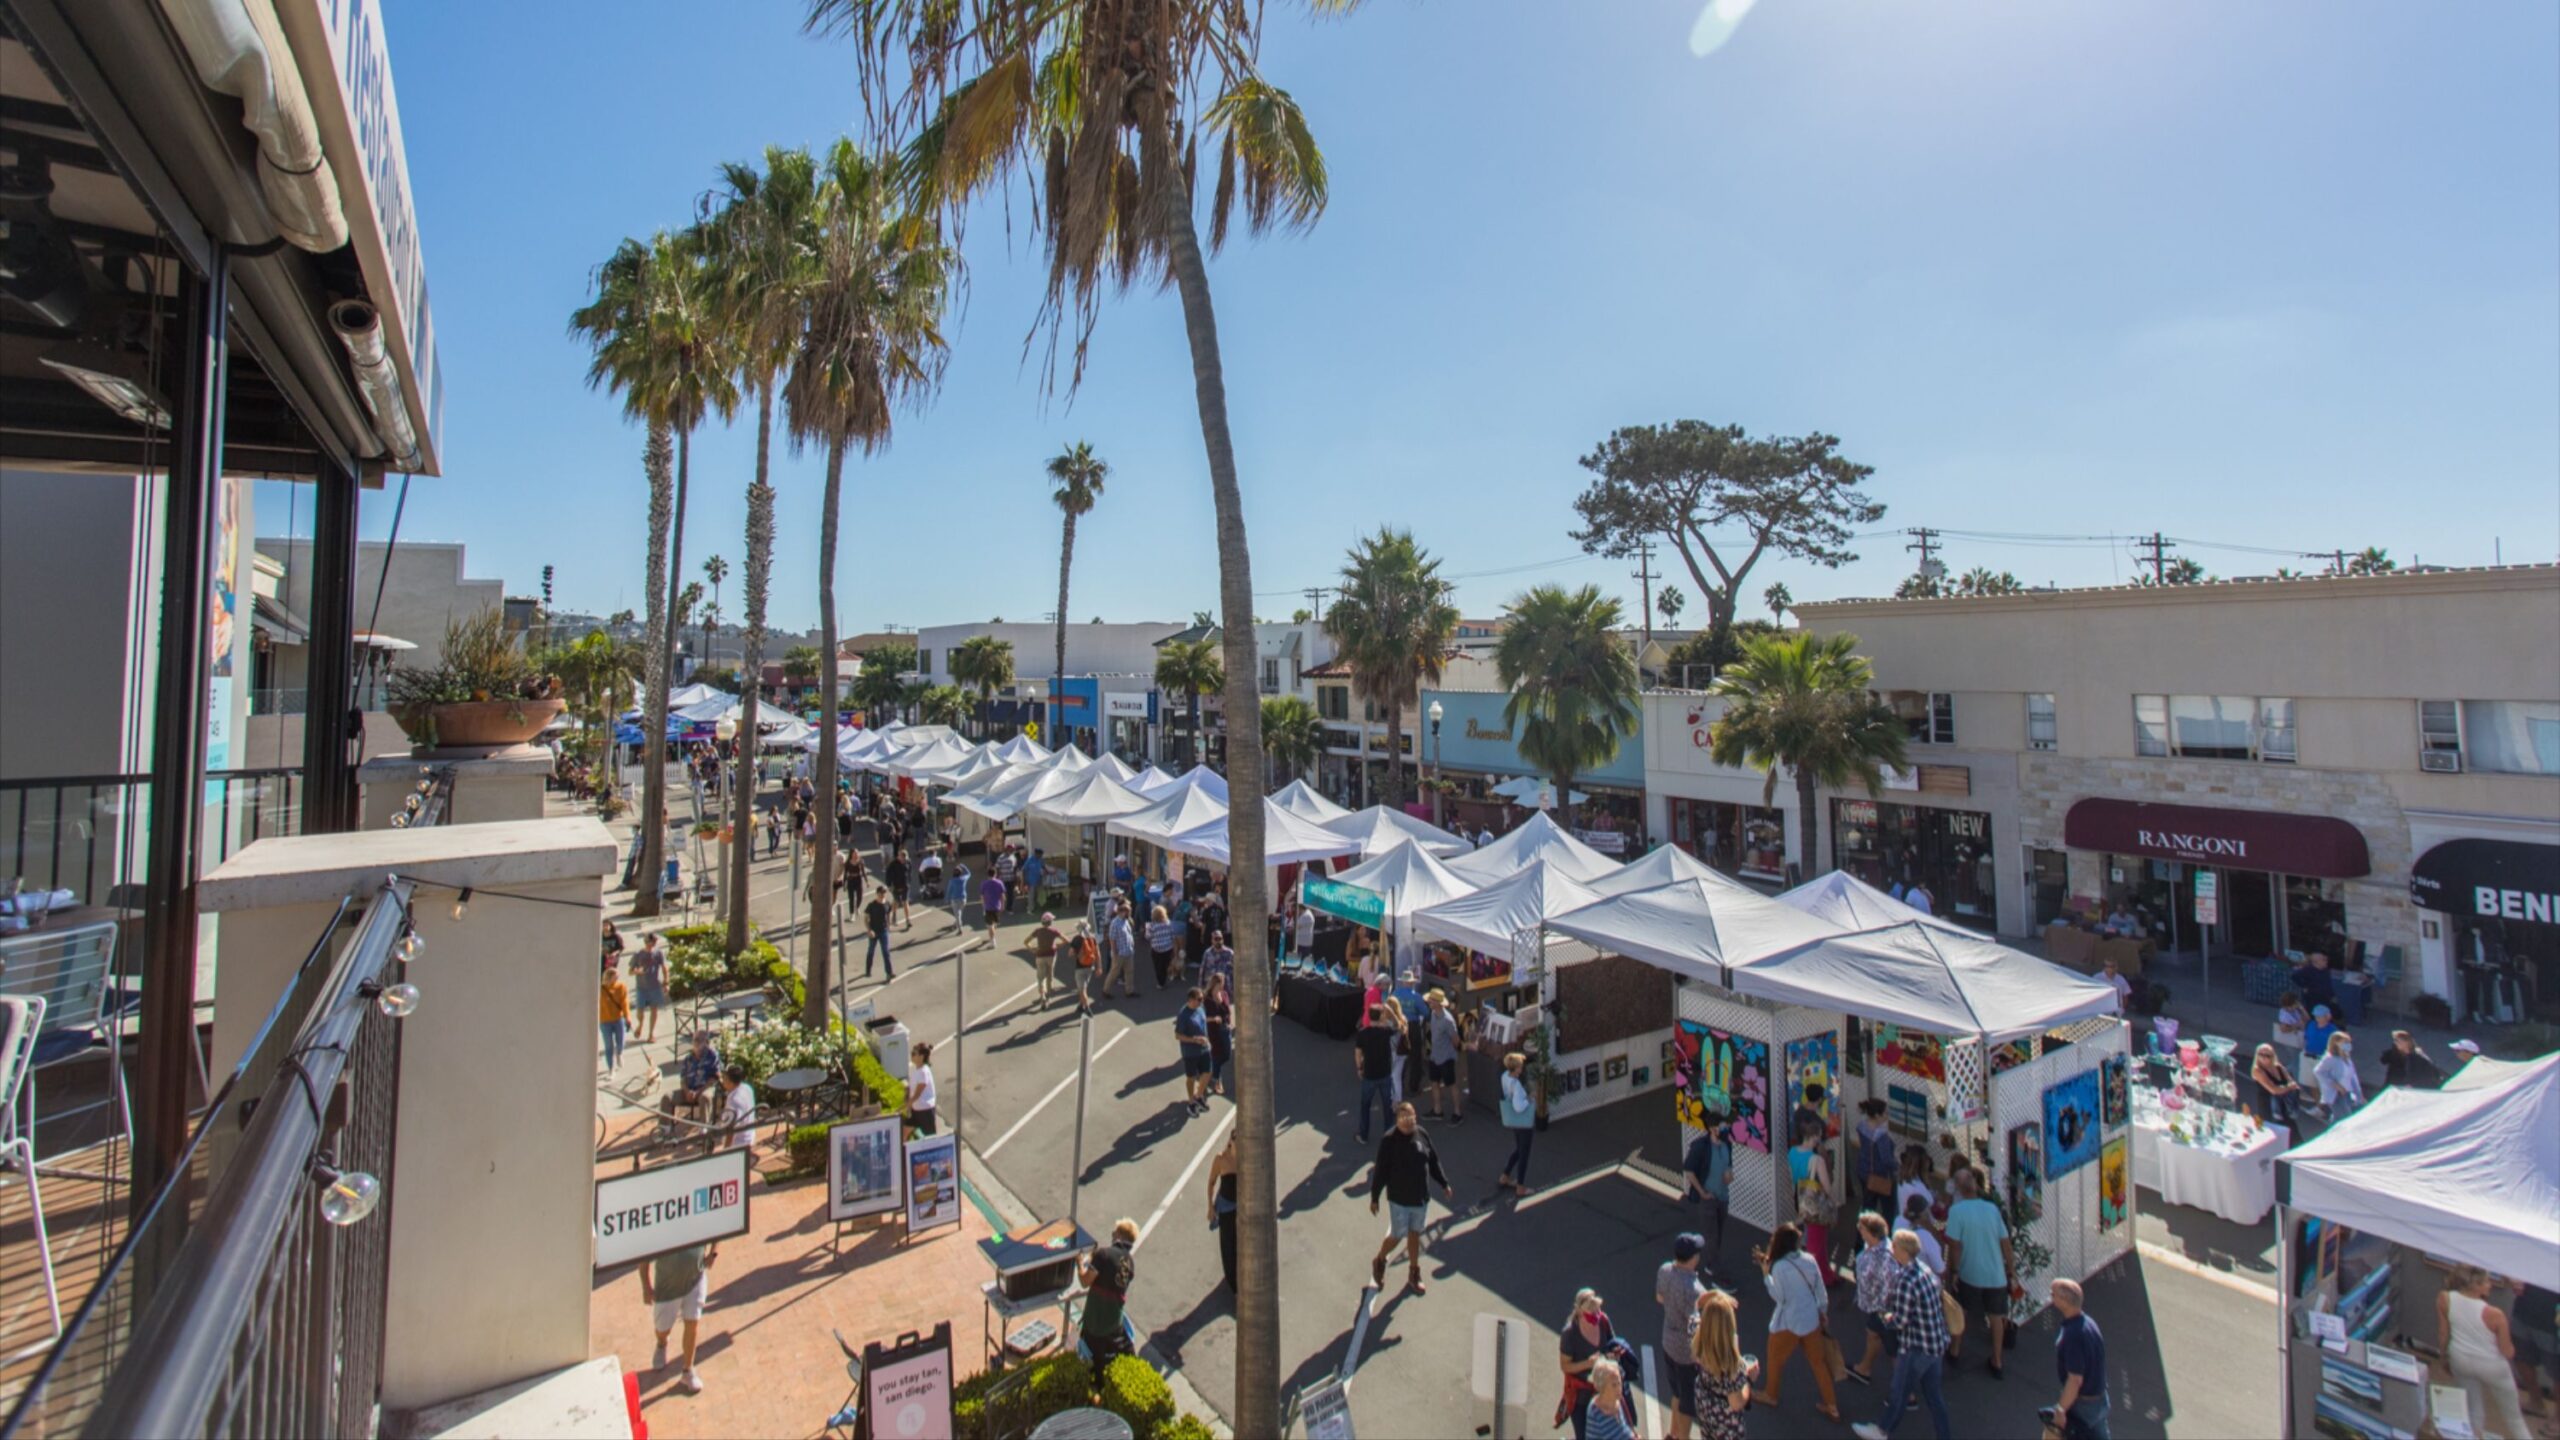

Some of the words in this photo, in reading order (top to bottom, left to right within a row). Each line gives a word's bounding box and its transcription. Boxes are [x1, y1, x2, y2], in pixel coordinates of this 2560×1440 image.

[1949, 813, 1985, 838] NEW
[2138, 829, 2246, 857] RANGONI
[2475, 886, 2560, 924] BEN
[603, 1194, 690, 1237] STRETCH
[878, 1381, 897, 1395] you
[899, 1373, 920, 1386] stay
[885, 1392, 902, 1405] san
